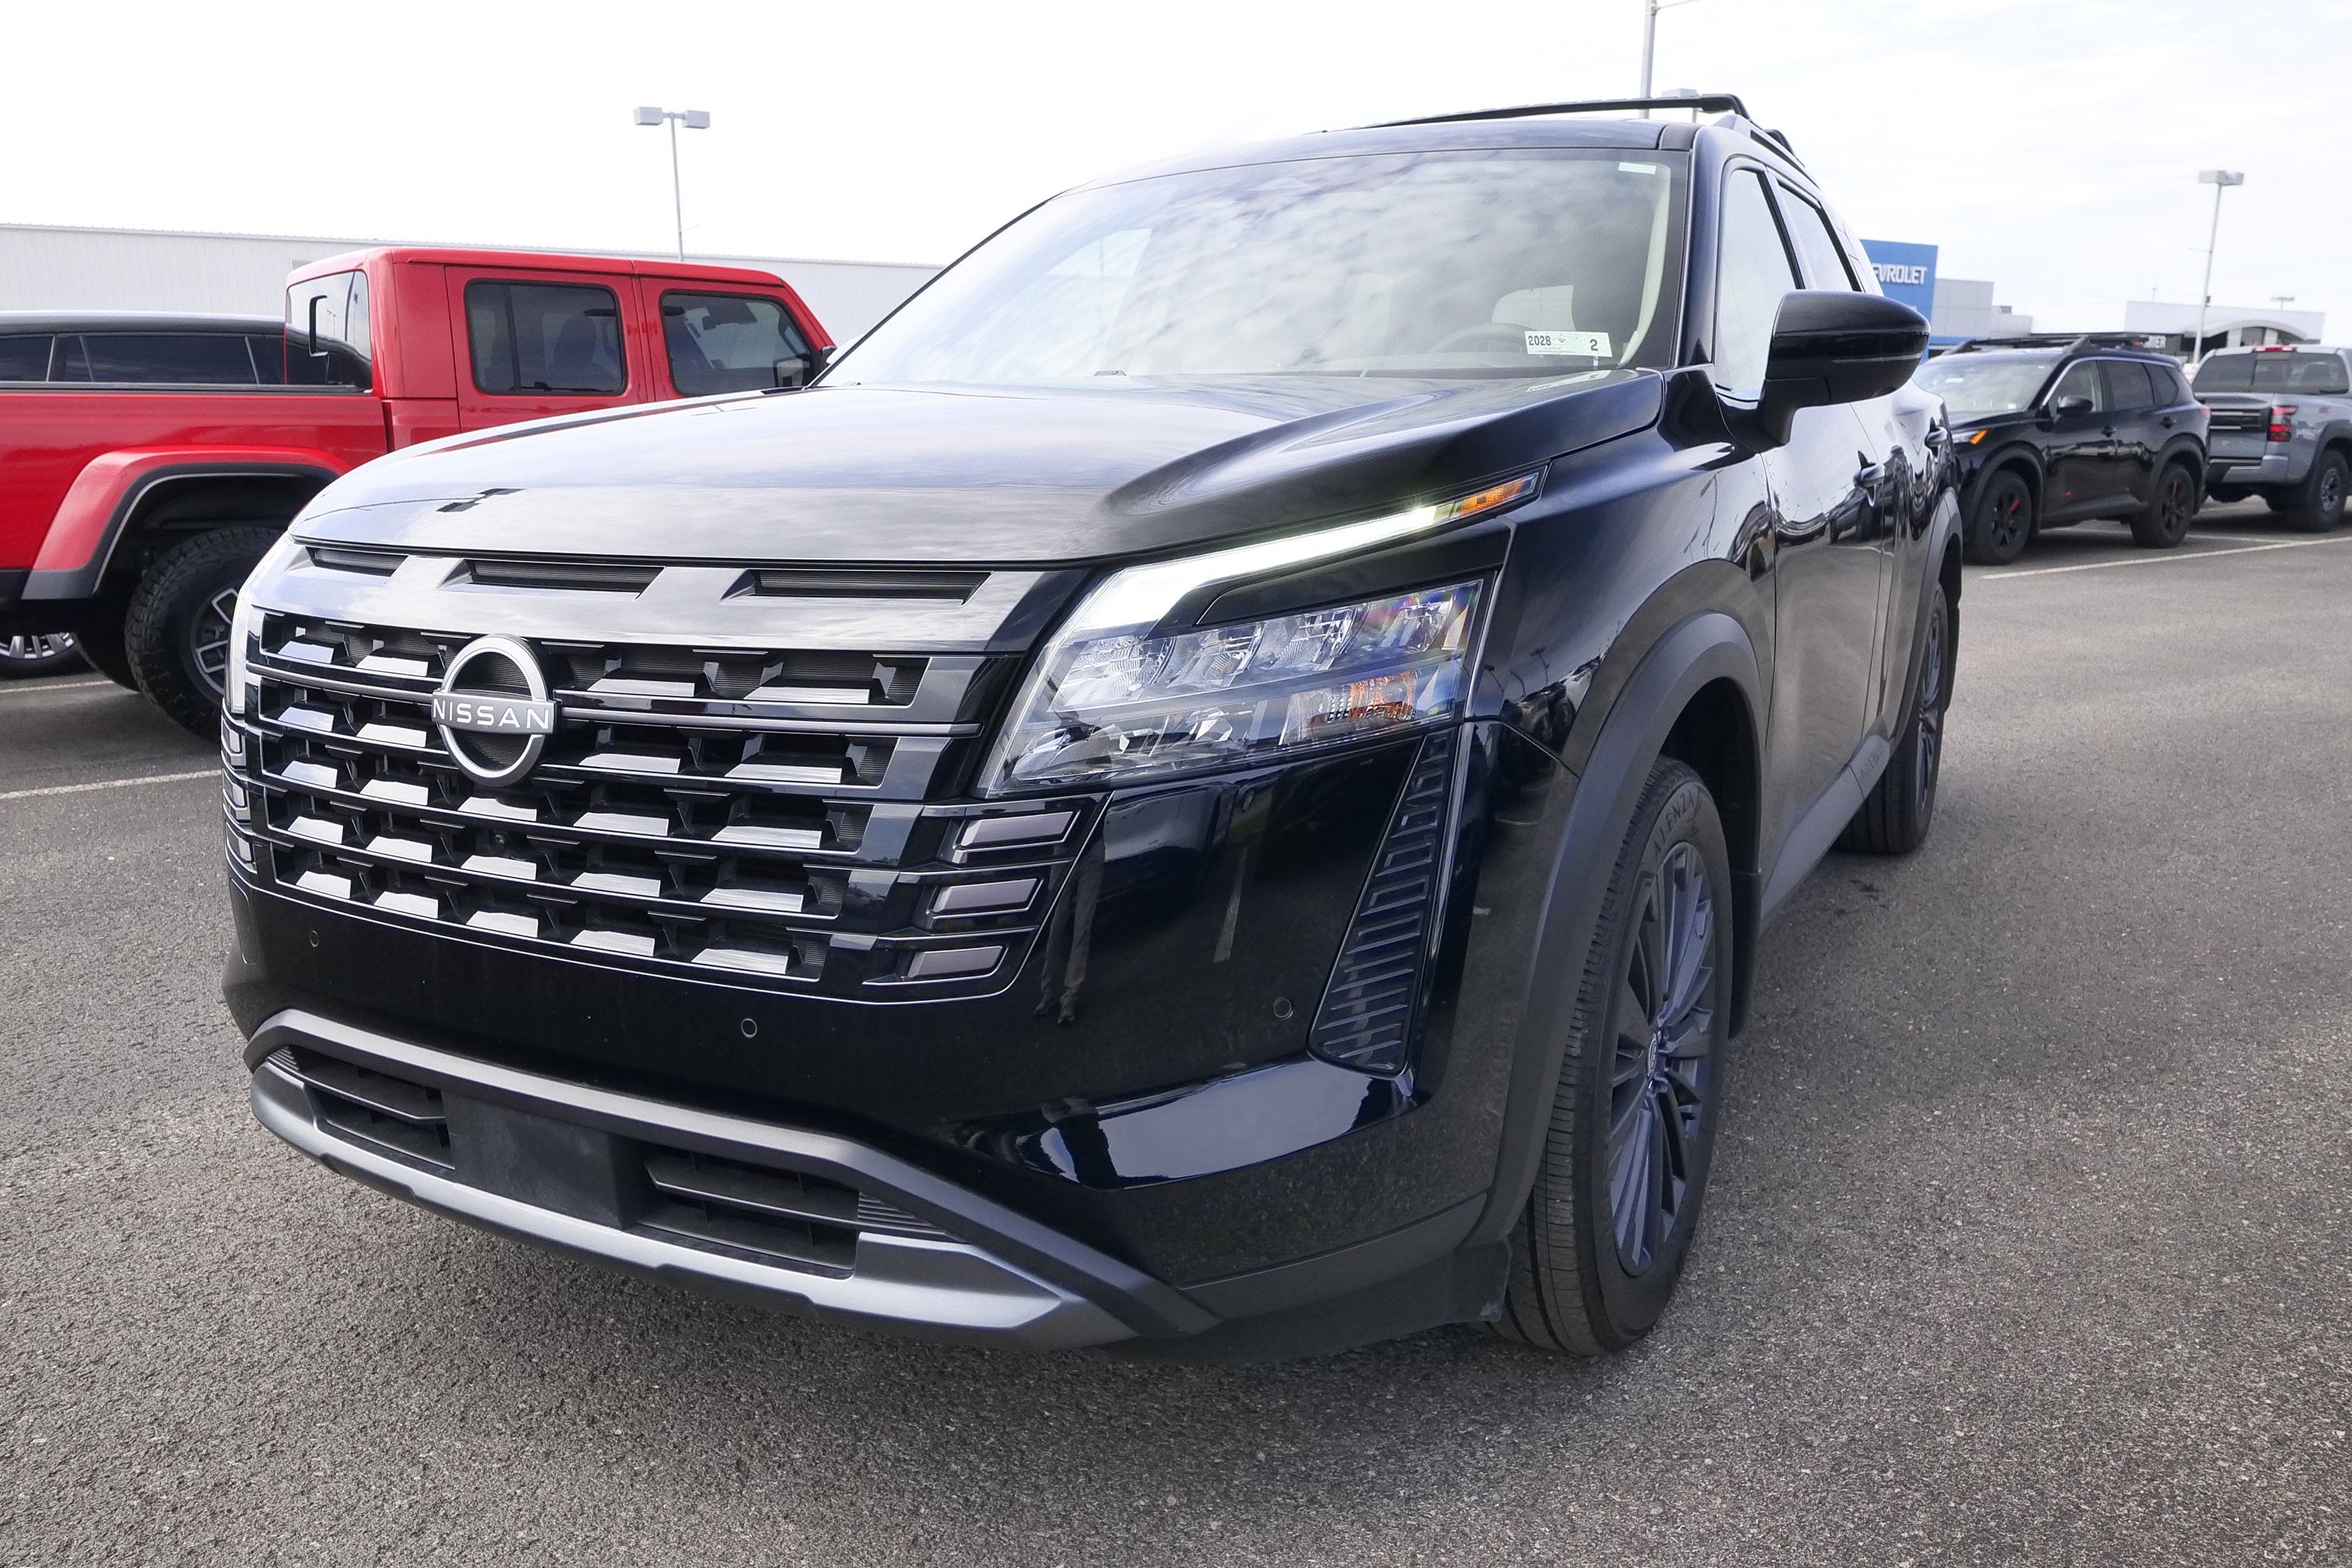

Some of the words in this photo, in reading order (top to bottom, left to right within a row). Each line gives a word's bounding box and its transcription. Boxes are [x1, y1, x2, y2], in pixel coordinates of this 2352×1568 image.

[1528, 335, 1552, 346] 2028
[1589, 338, 1599, 351] 2
[433, 697, 549, 729] NISSAN
